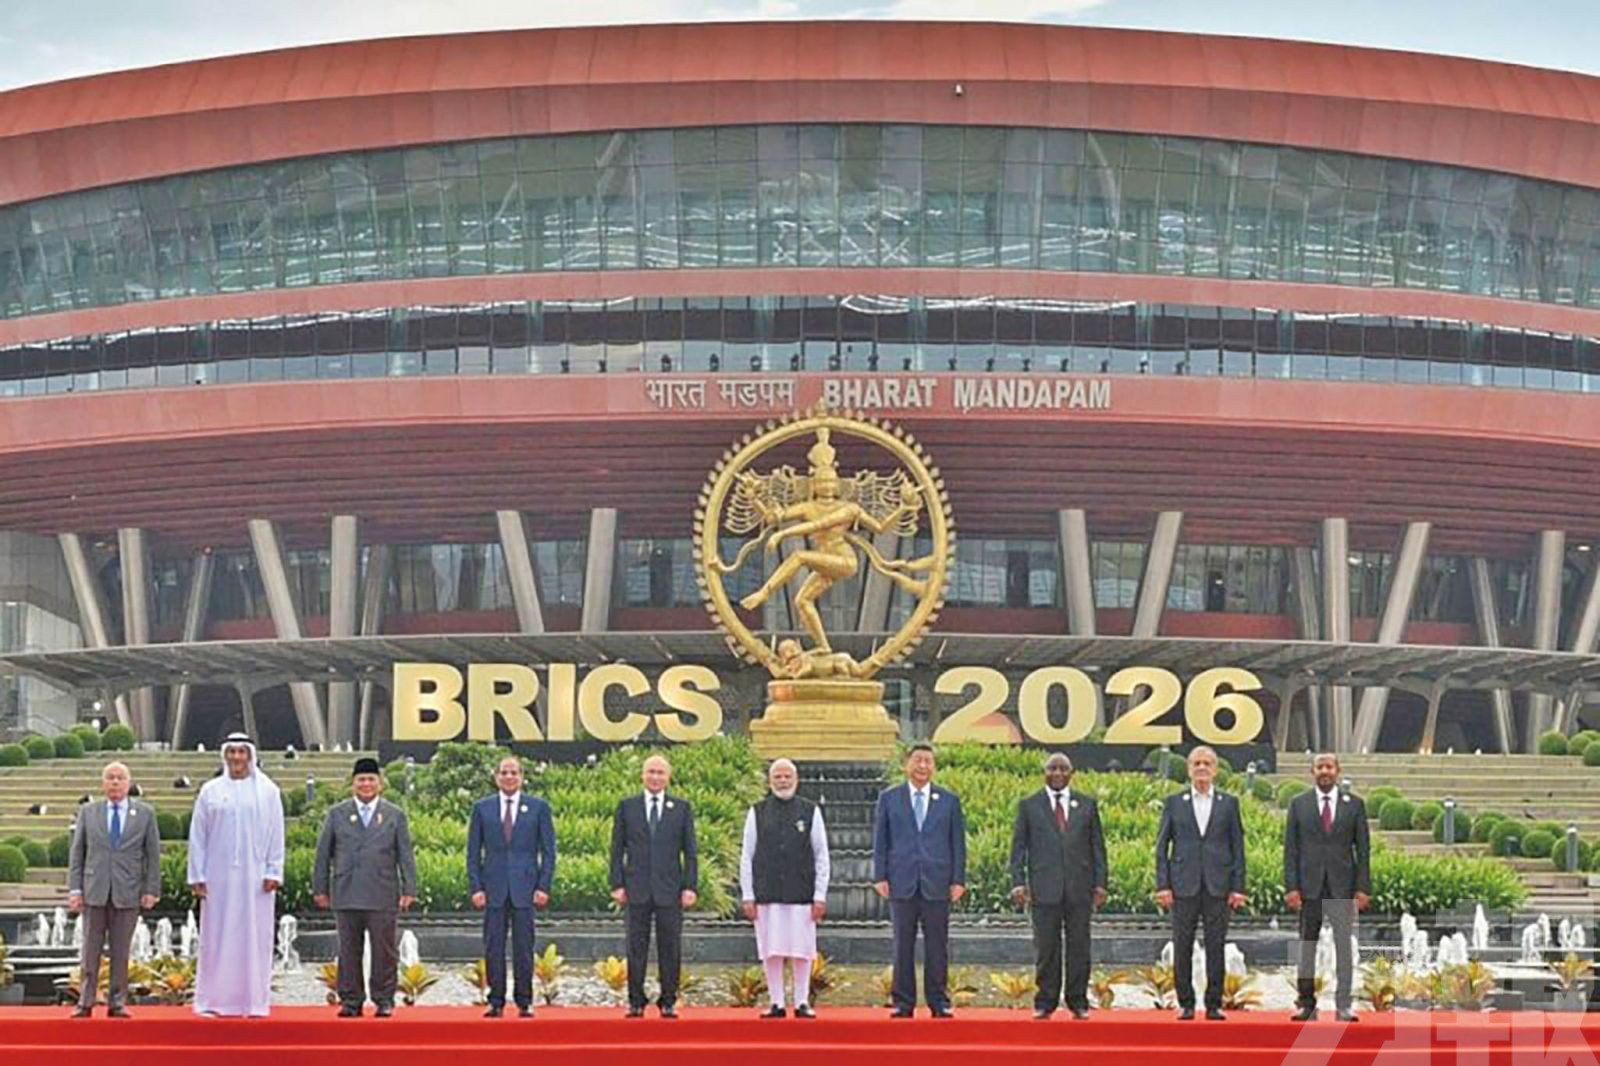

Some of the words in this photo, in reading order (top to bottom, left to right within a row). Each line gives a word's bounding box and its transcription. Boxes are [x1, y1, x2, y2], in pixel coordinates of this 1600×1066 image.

[646, 379, 705, 408] भारत
[823, 379, 937, 408] BHARAT
[954, 379, 1111, 409] MANDAPAM
[392, 662, 723, 742] BRICS
[932, 666, 1264, 744] 2026
